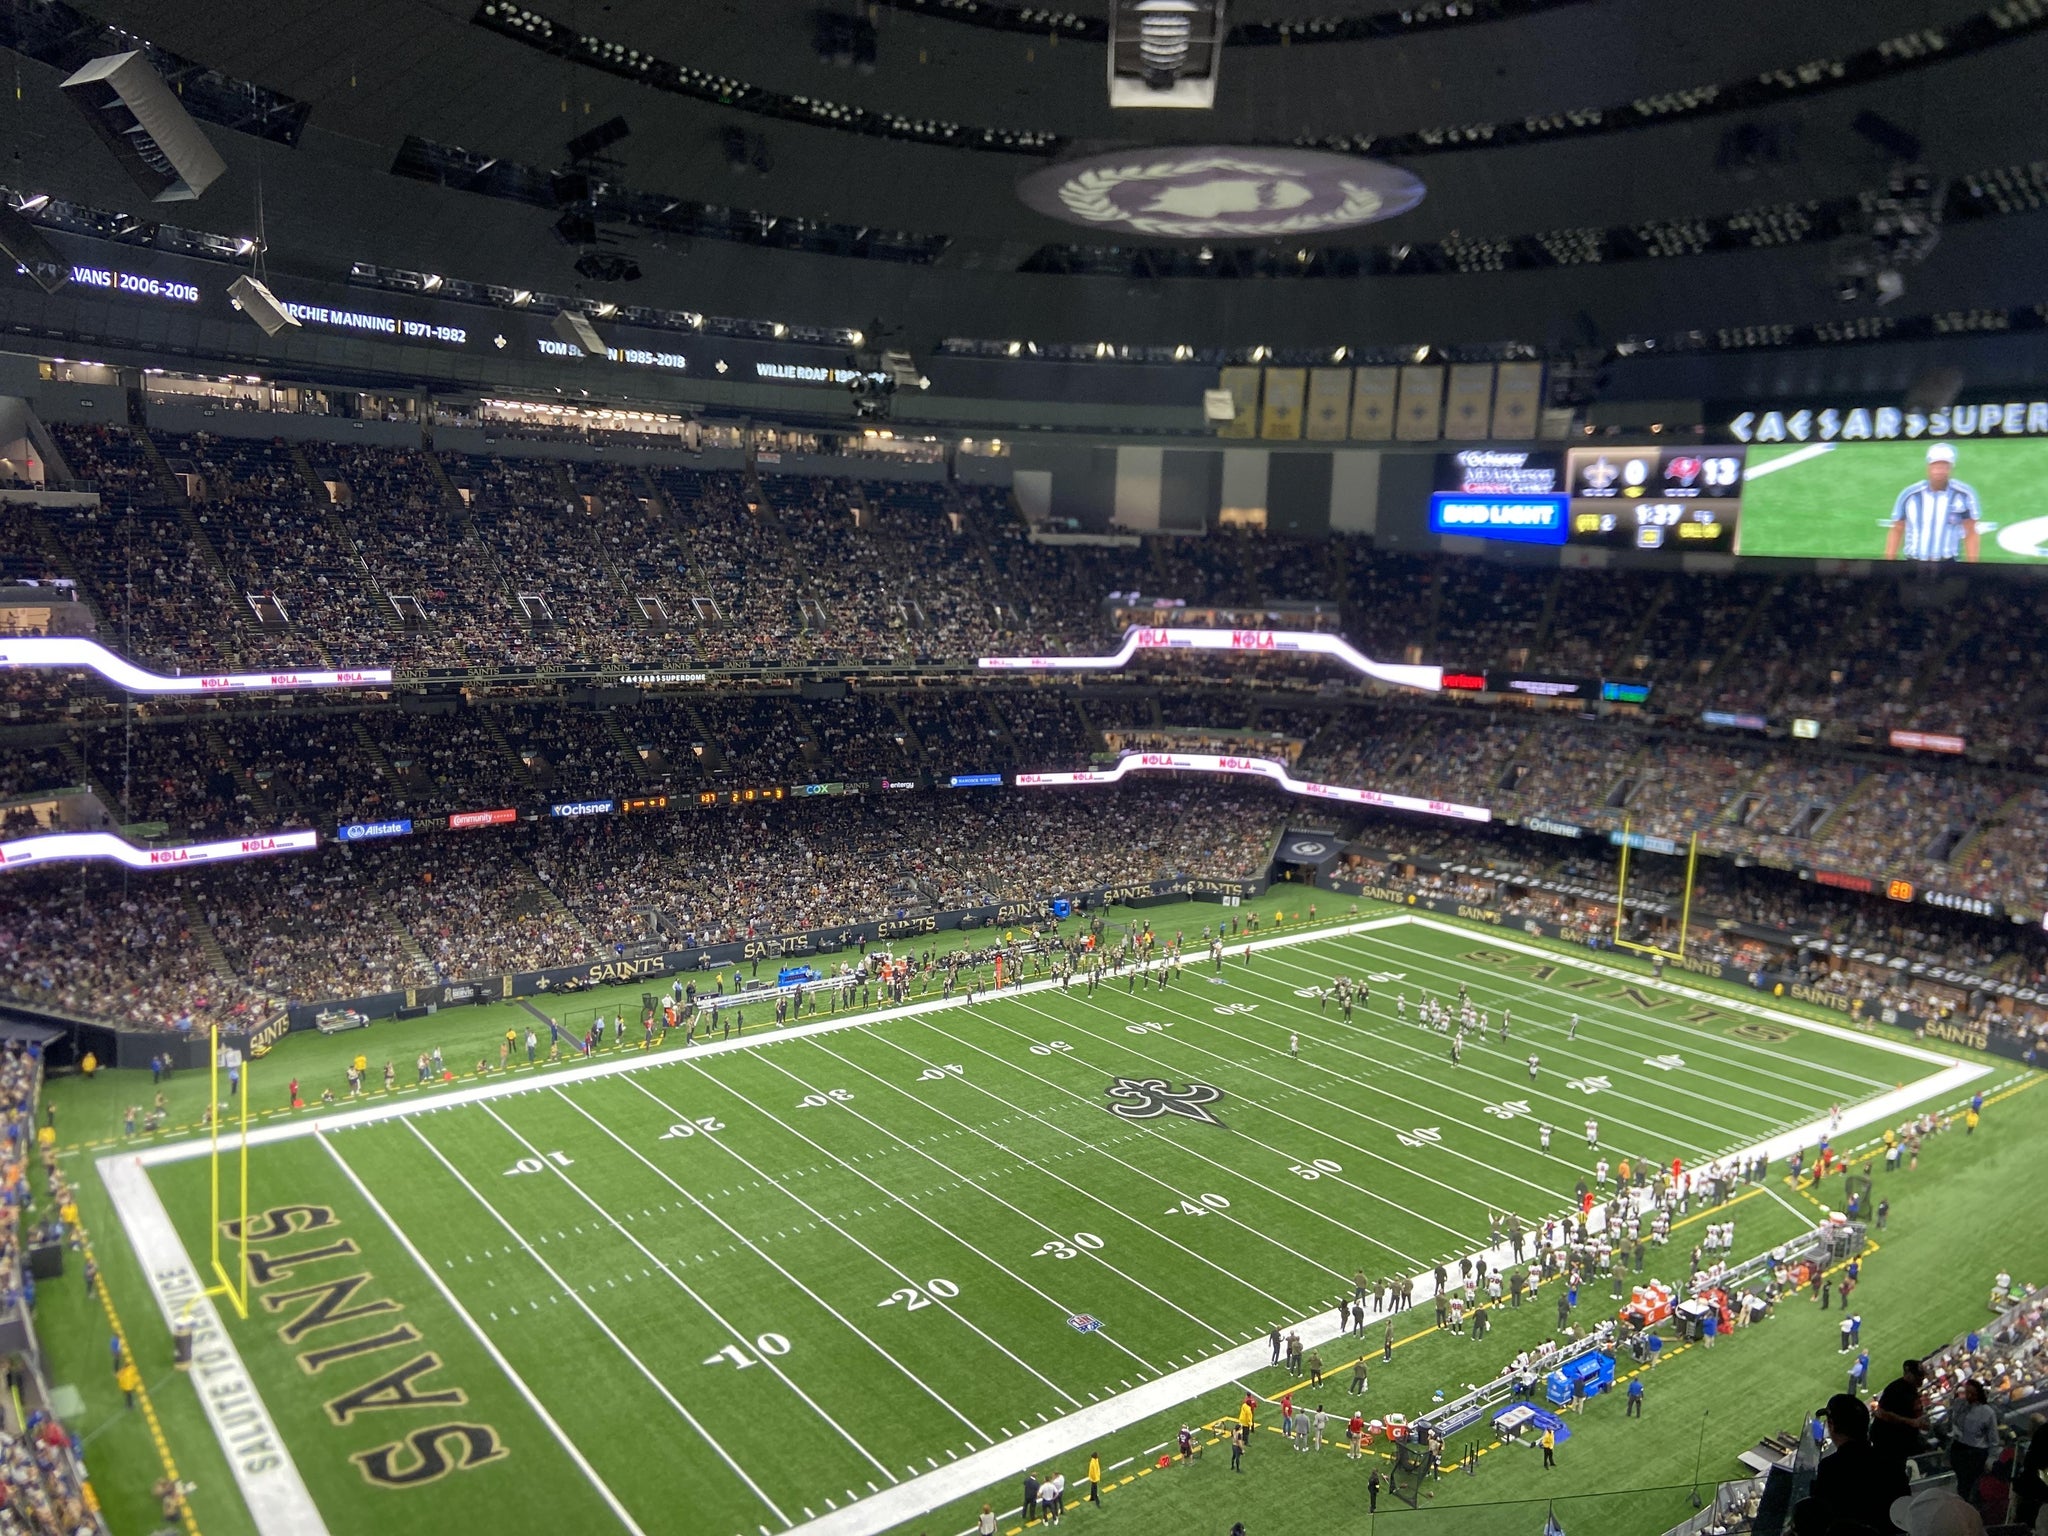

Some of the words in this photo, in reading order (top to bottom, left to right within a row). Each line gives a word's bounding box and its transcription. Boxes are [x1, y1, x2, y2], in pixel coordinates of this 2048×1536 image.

[70, 266, 111, 287] VANS
[120, 274, 199, 301] 2006-2016
[331, 311, 395, 333] MANNING
[403, 321, 466, 343] 1971-1982
[537, 339, 566, 356] TOM
[625, 349, 686, 368] 1985-2018
[756, 363, 796, 379] WILLIE
[797, 366, 829, 381] ROAF
[1443, 504, 1489, 524] BUD
[1490, 504, 1555, 525] LIGHT
[1232, 630, 1274, 649] NOLA
[395, 670, 429, 679] SAINTS
[467, 667, 500, 676] SAINTS
[535, 665, 566, 674] SAINTS
[600, 664, 630, 672] SAINTS
[662, 662, 691, 670] SAINTS
[620, 675, 661, 683] CAESARS
[661, 674, 706, 682] SUPERDOME
[1142, 754, 1173, 766] NOLA
[1219, 756, 1251, 770] NOLA
[890, 781, 914, 790] entergy
[1020, 774, 1041, 783] NOLA
[1073, 772, 1093, 782] NOLA
[806, 784, 828, 795] COX
[561, 802, 611, 816] Ochsner
[414, 817, 446, 829] SAINTS
[454, 813, 492, 826] Community
[1530, 818, 1580, 838] Ochsner
[365, 824, 402, 836] Allstate
[241, 838, 275, 853] NOLA
[151, 849, 188, 864] NOLA
[1363, 885, 1404, 904] SAINTS
[590, 955, 665, 981] SAINTS
[1791, 983, 1850, 1012] SAINTS
[250, 1013, 291, 1048] SAINTS
[1125, 1021, 1164, 1035] 40
[1925, 1020, 1988, 1051] SAINTS
[1030, 1040, 1075, 1056] 50
[923, 1063, 965, 1080] 40
[803, 1088, 855, 1108] 30
[669, 1116, 726, 1138] 20
[1396, 1127, 1442, 1149] 40
[516, 1150, 575, 1174] 10
[1288, 1158, 1343, 1181] 50
[1180, 1192, 1231, 1217] 40
[1043, 1232, 1105, 1260] 30
[891, 1278, 960, 1311] 20
[219, 1204, 511, 1490] SAINTS
[720, 1332, 791, 1370] 10
[196, 1349, 237, 1378] TO
[208, 1379, 282, 1475] SALUTE
[1393, 1427, 1401, 1438] G
